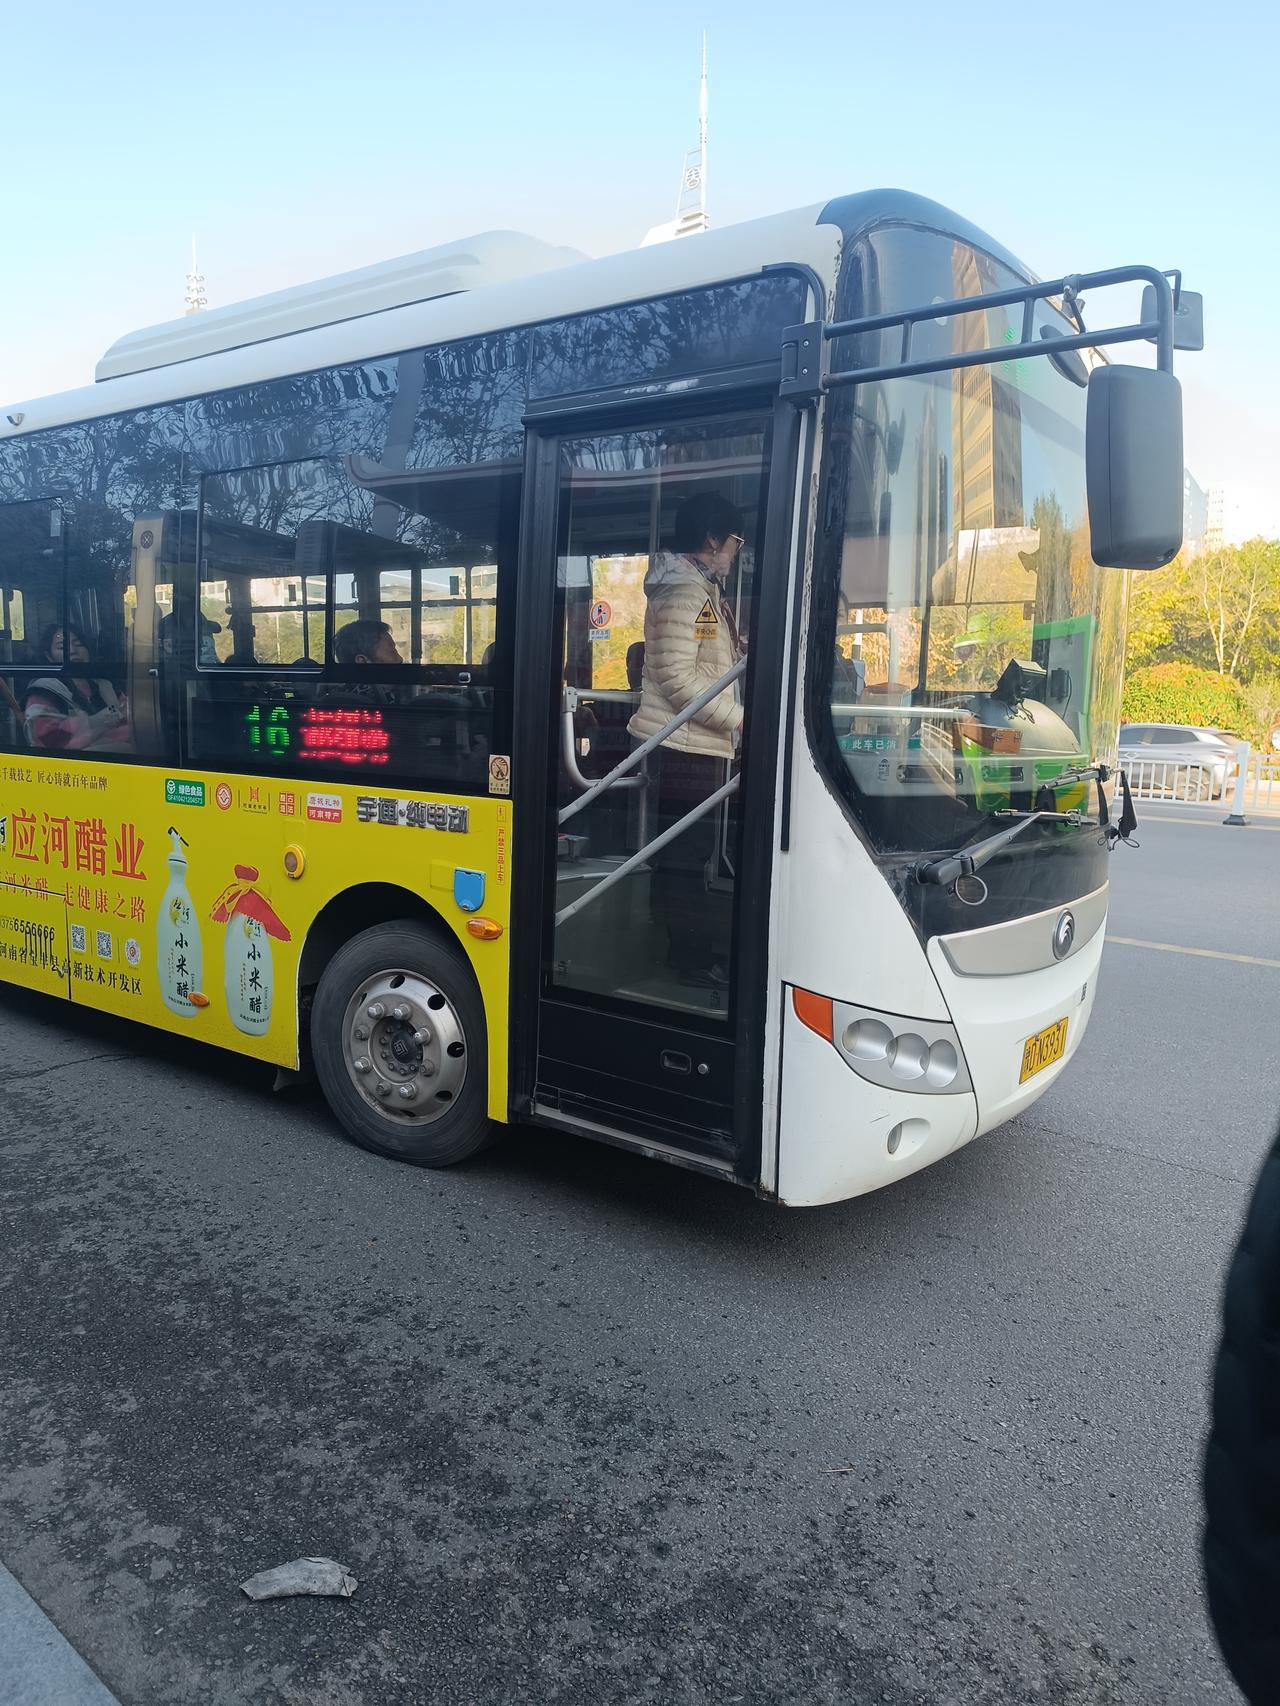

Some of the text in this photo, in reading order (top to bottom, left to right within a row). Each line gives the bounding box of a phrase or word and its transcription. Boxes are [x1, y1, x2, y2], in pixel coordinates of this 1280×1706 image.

[246, 705, 290, 754] 16
[37, 770, 108, 791] 匠心铸就百年品牌
[11, 808, 148, 881] 应河醋业
[0, 870, 146, 923] 河米醋 走健康之路
[174, 932, 189, 999] 小米醋
[247, 944, 263, 1015] 小米醋
